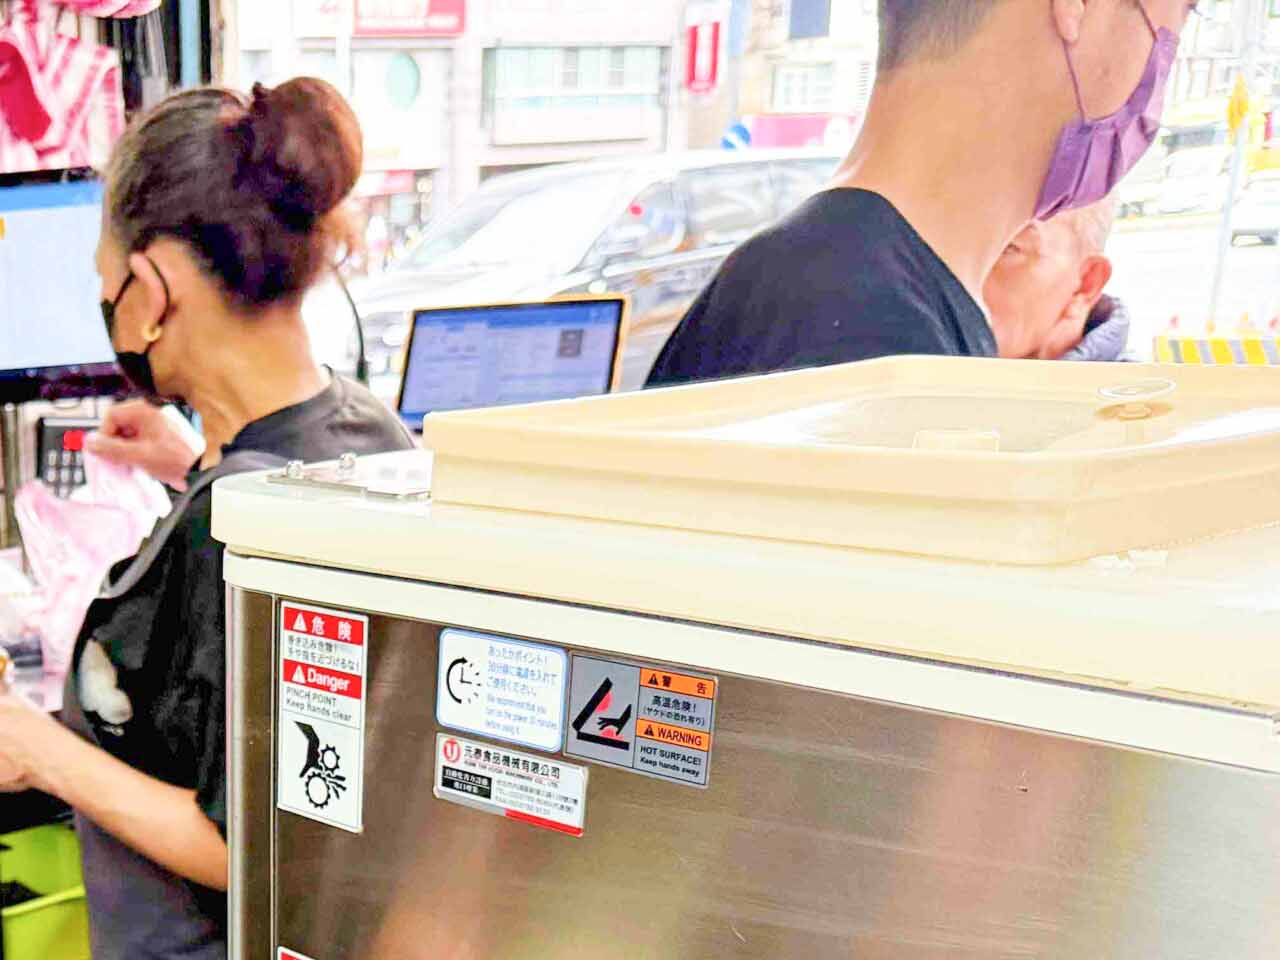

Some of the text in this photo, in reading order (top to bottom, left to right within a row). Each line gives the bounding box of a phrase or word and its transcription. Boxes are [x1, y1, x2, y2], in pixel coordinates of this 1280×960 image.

[307, 667, 351, 692] Danger
[286, 686, 337, 707] PINCH POINT
[286, 698, 305, 711] Keep
[306, 702, 330, 717] hands
[657, 726, 703, 747] WARNING
[640, 745, 658, 756] HOT
[640, 756, 658, 767] Keep
[658, 760, 680, 772] hands
